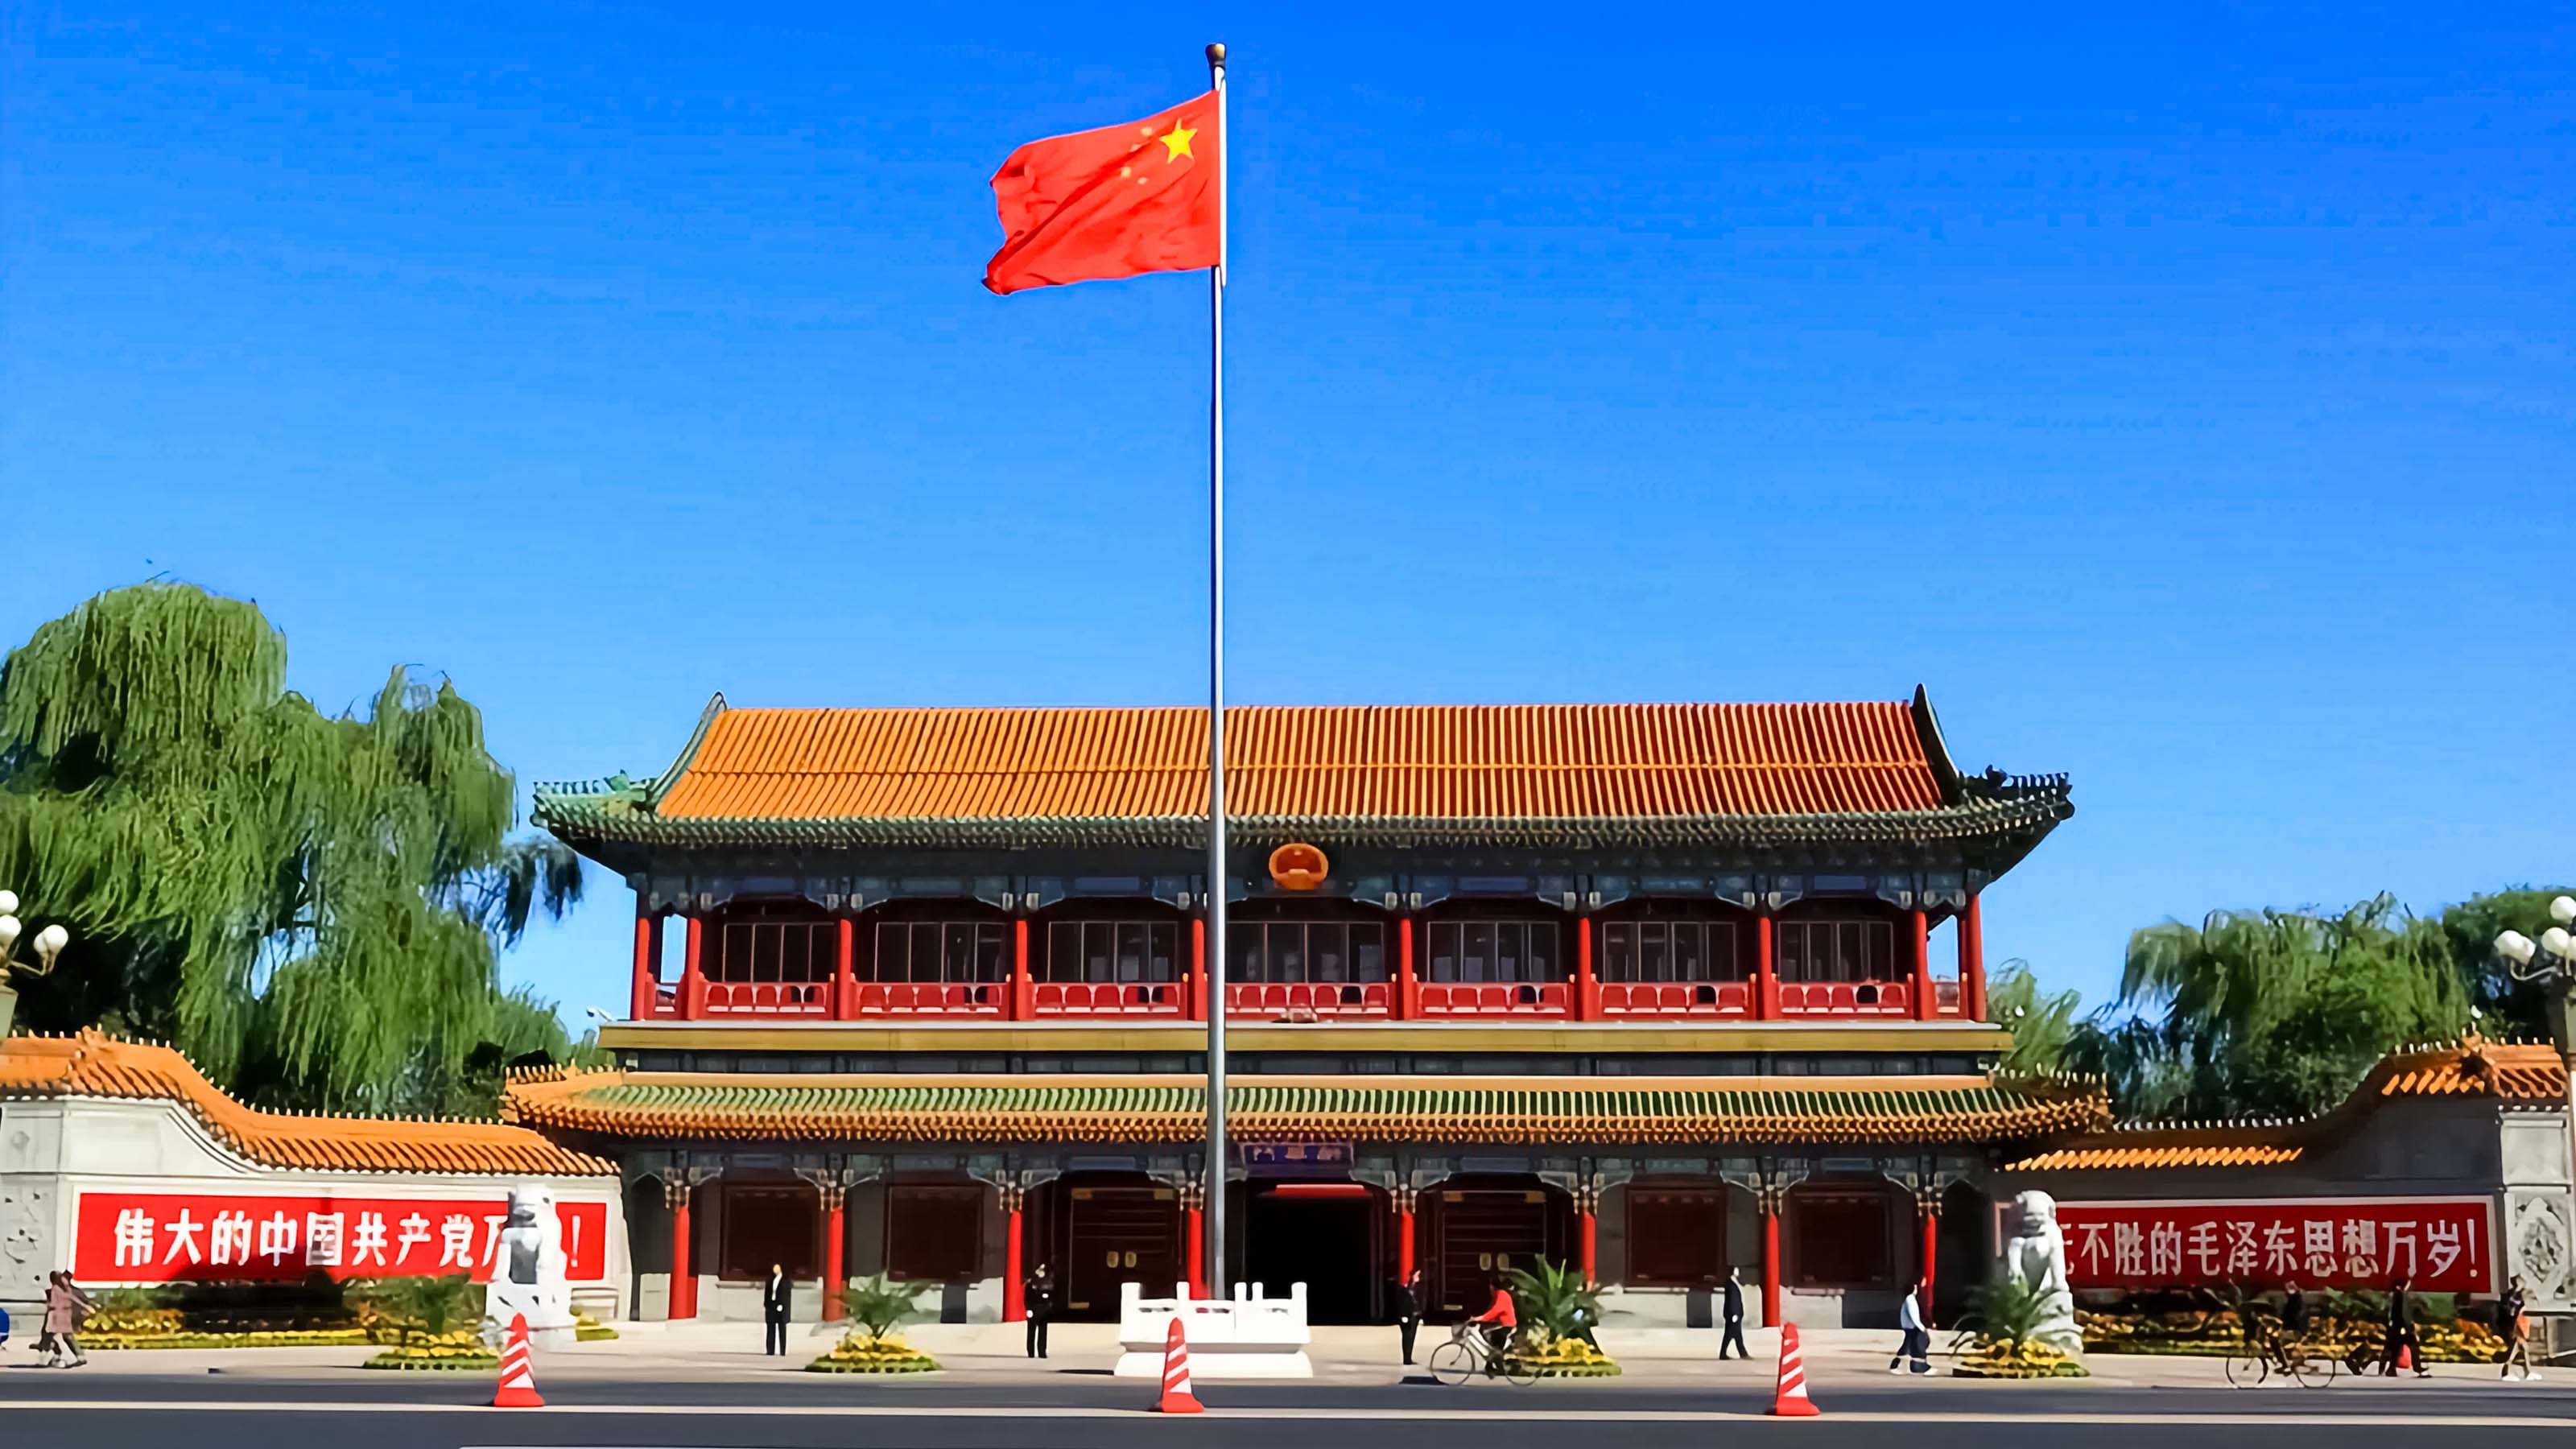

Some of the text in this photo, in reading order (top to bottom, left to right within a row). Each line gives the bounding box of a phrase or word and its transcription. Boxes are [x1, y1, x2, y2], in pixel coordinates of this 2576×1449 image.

[114, 1208, 581, 1268] 伟大的中国共产党!
[2058, 1219, 2478, 1278] 不胜的毛泽东思想万岁!
